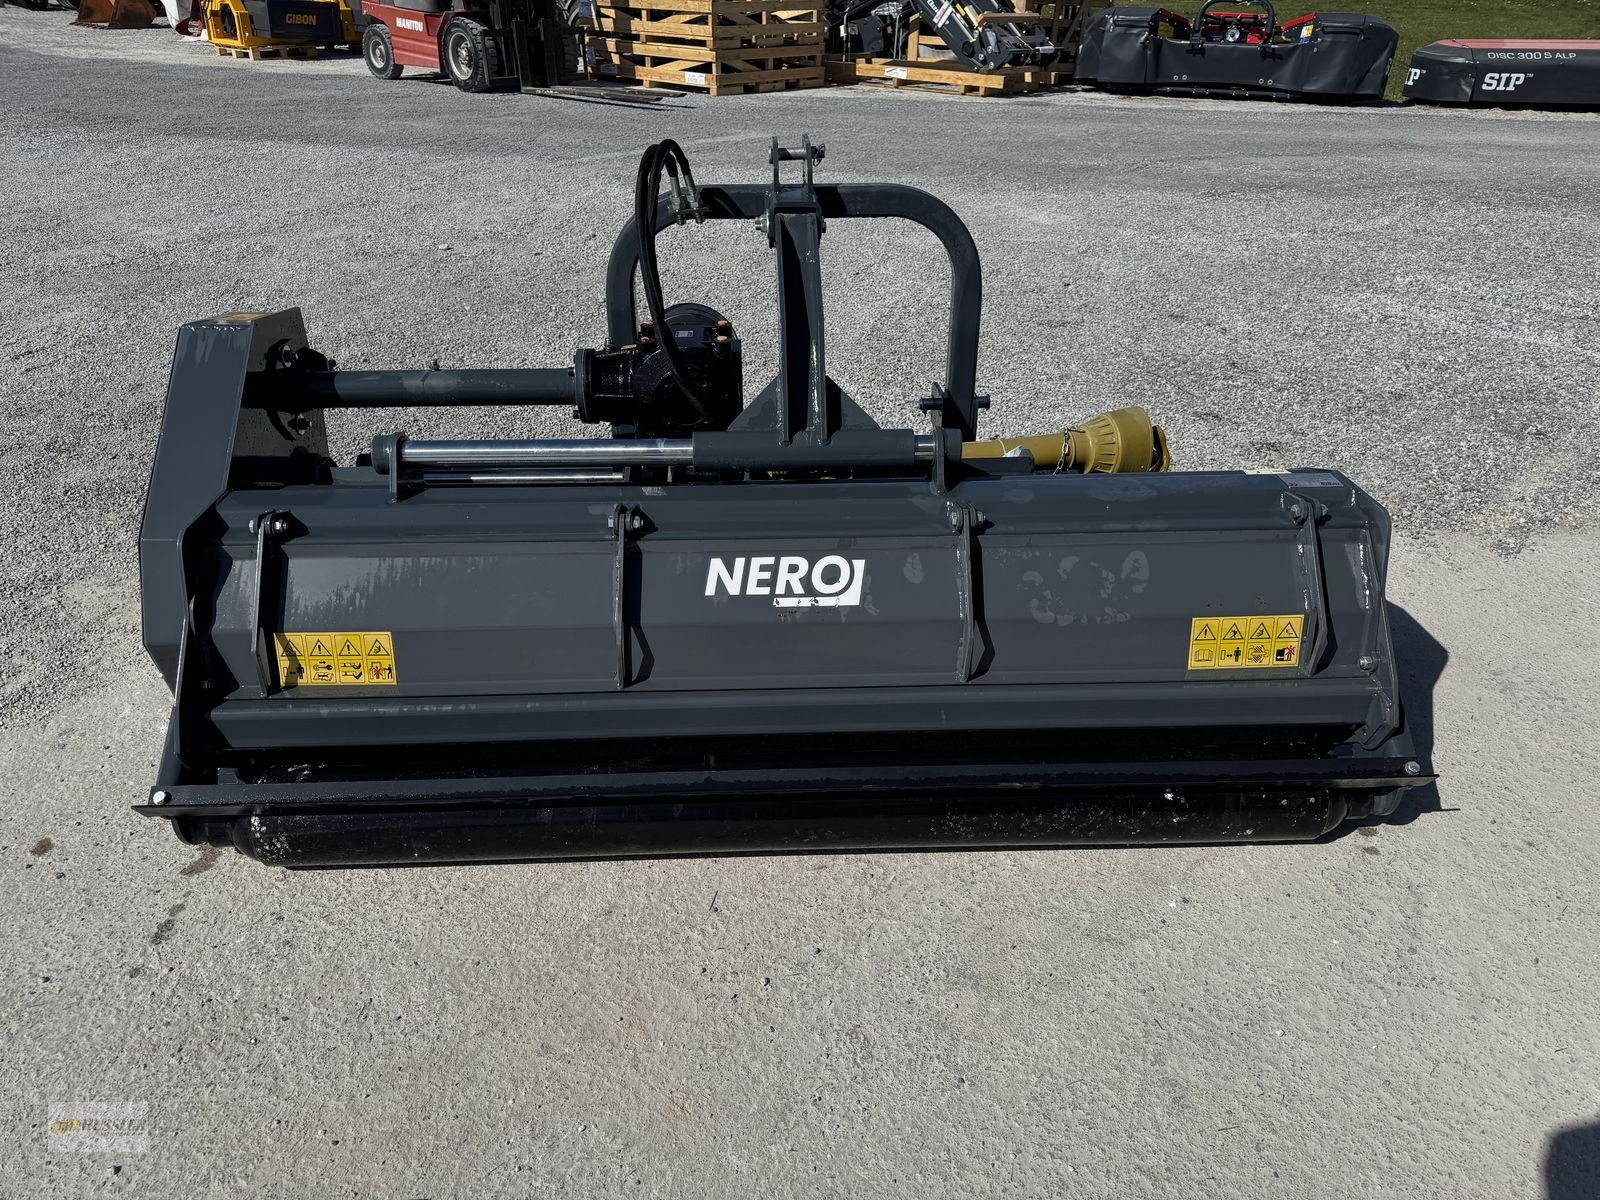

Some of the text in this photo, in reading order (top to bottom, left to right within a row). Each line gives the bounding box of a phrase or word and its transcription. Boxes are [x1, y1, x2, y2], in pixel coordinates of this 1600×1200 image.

[286, 13, 316, 25] GIBON
[396, 17, 423, 32] MANITOU
[1487, 52, 1515, 60] DISC
[1517, 51, 1542, 60] 300
[704, 554, 851, 597] NERO
